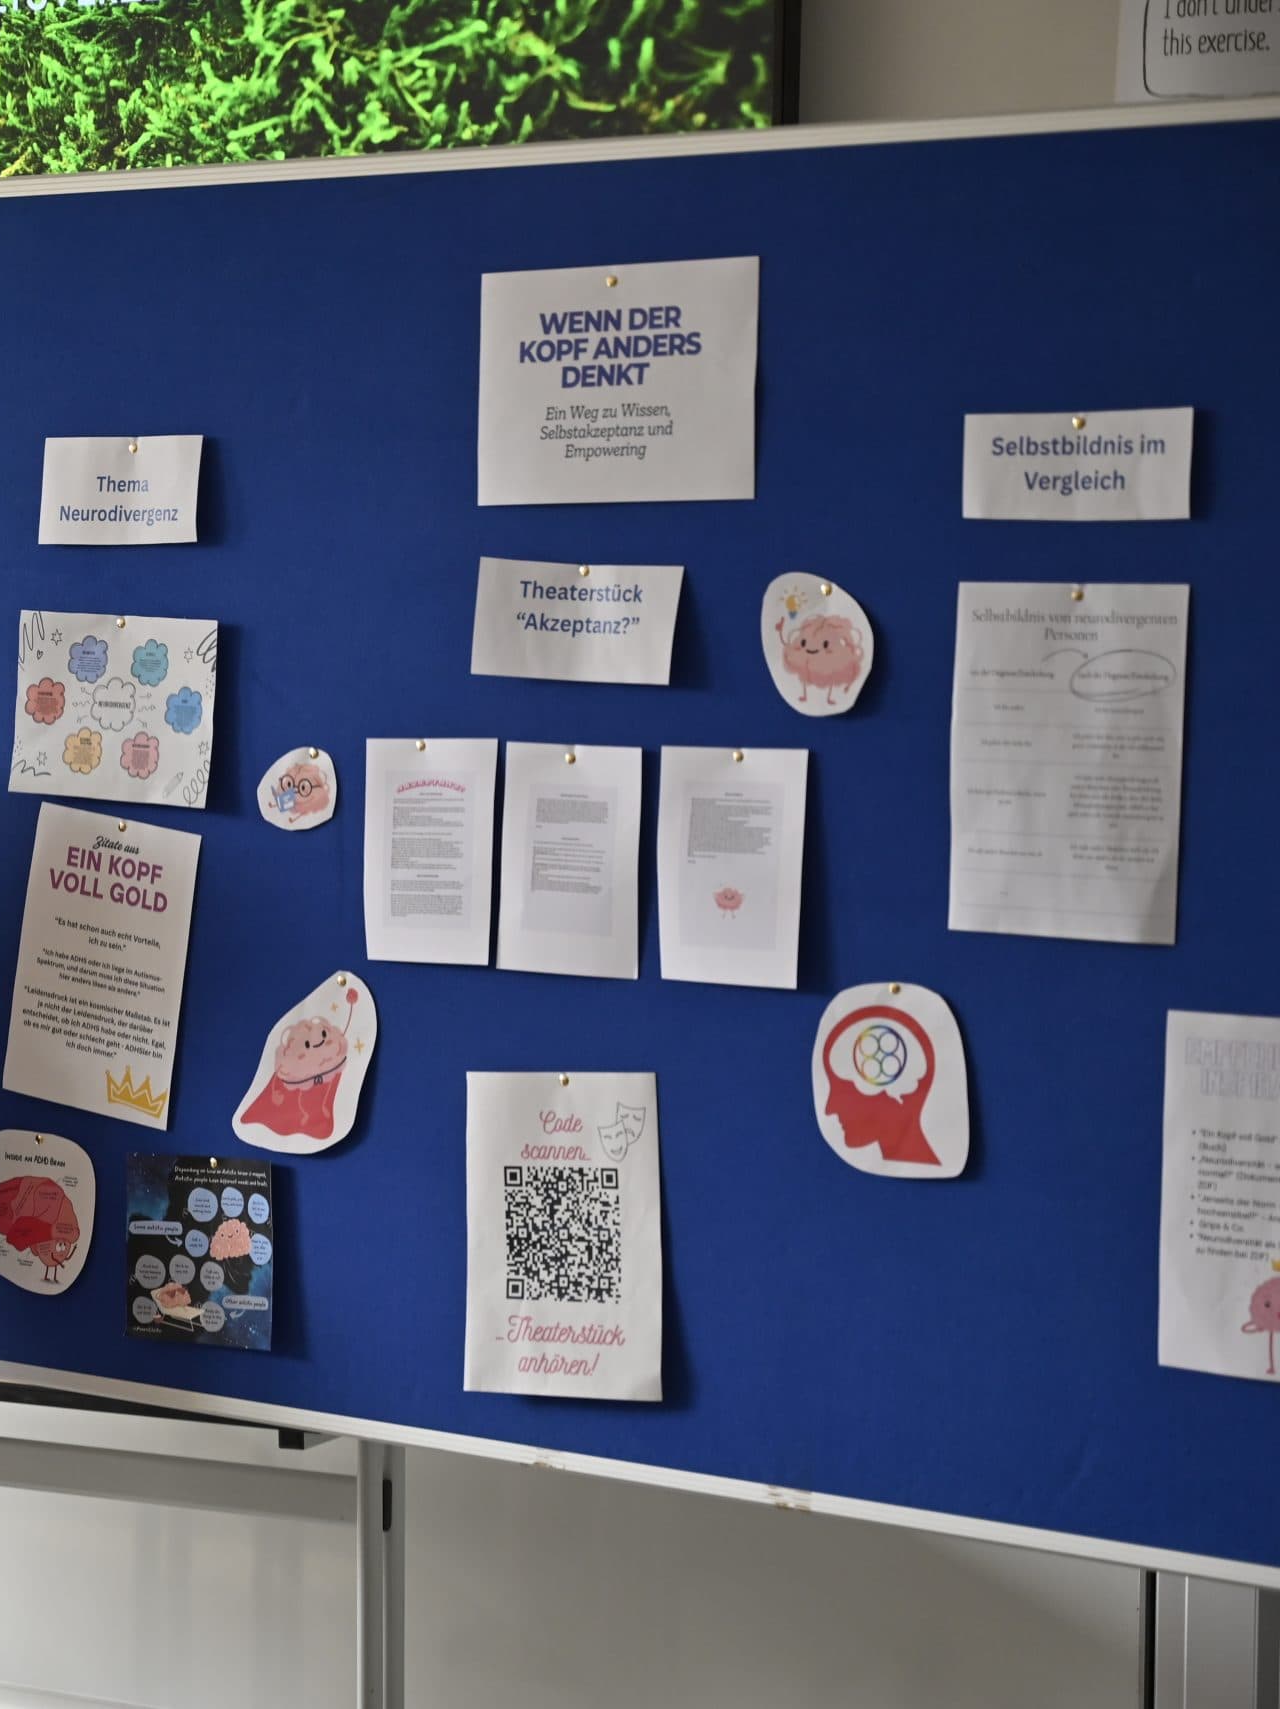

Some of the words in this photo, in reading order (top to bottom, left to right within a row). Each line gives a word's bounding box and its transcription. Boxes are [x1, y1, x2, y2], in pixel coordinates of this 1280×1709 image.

[1177, 0, 1218, 18] dont
[1163, 27, 1192, 56] this
[1198, 29, 1270, 54] exercise.
[539, 309, 622, 335] WENN
[628, 305, 682, 331] DER
[519, 338, 589, 364] KOPF
[593, 332, 702, 361] ANDERS
[561, 362, 650, 389] DENKT
[545, 406, 567, 422] Ein
[569, 404, 599, 423] Weg
[602, 407, 617, 418] zu
[620, 402, 671, 418] Wissen,
[540, 423, 644, 441] Selbstakzeptanz
[648, 421, 673, 436] und
[564, 443, 647, 461] Empowering
[991, 434, 1134, 457] Selbstbildnis
[1140, 434, 1166, 455] im
[97, 475, 149, 493] Thema
[1024, 469, 1125, 496] Vergleich
[59, 505, 179, 526] Neurodivergenz
[520, 580, 643, 603] Theaterstück
[516, 611, 640, 638] “Akzeptanz?”
[971, 608, 1045, 624] Selbstbildnis
[1048, 613, 1073, 624] von
[1075, 610, 1178, 630] neurodivergenten
[1044, 627, 1098, 641] Personen
[92, 835, 123, 851] Zitate
[123, 844, 140, 855] aus
[66, 846, 102, 873] EIN
[108, 855, 163, 885] KOPF
[49, 868, 104, 900] VOLL
[110, 882, 168, 913] GOLD
[67, 919, 78, 929] hat
[79, 922, 99, 934] schon
[100, 927, 116, 938] auch
[117, 931, 132, 942] echt
[99, 940, 108, 948] zu
[55, 951, 69, 960] habe
[70, 954, 87, 965] ADHS
[88, 959, 101, 967] oder
[101, 961, 111, 970] ich
[37, 956, 65, 971] Spektrum,
[67, 964, 78, 973] und
[79, 967, 98, 977] darum
[113, 974, 123, 983] ich
[139, 980, 166, 993] Situation
[59, 972, 70, 981] hier
[71, 976, 91, 987] anders
[37, 1000, 43, 1009] ja
[44, 1002, 60, 1011] nicht
[61, 1005, 73, 1014] der
[73, 1008, 116, 1026] Leidensdruck,
[117, 1019, 128, 1027] der
[128, 1022, 153, 1034] darüber
[68, 996, 78, 1005] ist
[78, 999, 89, 1007] ein
[89, 1000, 124, 1016] kosmischer
[153, 1017, 161, 1025] Es
[162, 1018, 171, 1028] ist
[22, 1008, 60, 1024] entscheidet,
[61, 1016, 70, 1025] ob
[70, 1019, 81, 1027] ich
[82, 1021, 100, 1033] ADHS
[100, 1026, 116, 1036] habe
[117, 1031, 131, 1040] oder
[23, 1019, 31, 1027] ob
[40, 1023, 51, 1031] mir
[51, 1027, 62, 1035] gut
[63, 1029, 78, 1038] oder
[79, 1033, 105, 1046] schlecht
[105, 1040, 120, 1049] geht
[152, 1050, 163, 1060] bin
[65, 1039, 75, 1048] ich
[76, 1042, 92, 1053] doch
[539, 1110, 583, 1134] Code
[33, 1154, 49, 1166] ADHD
[518, 1353, 600, 1377] anhören!
